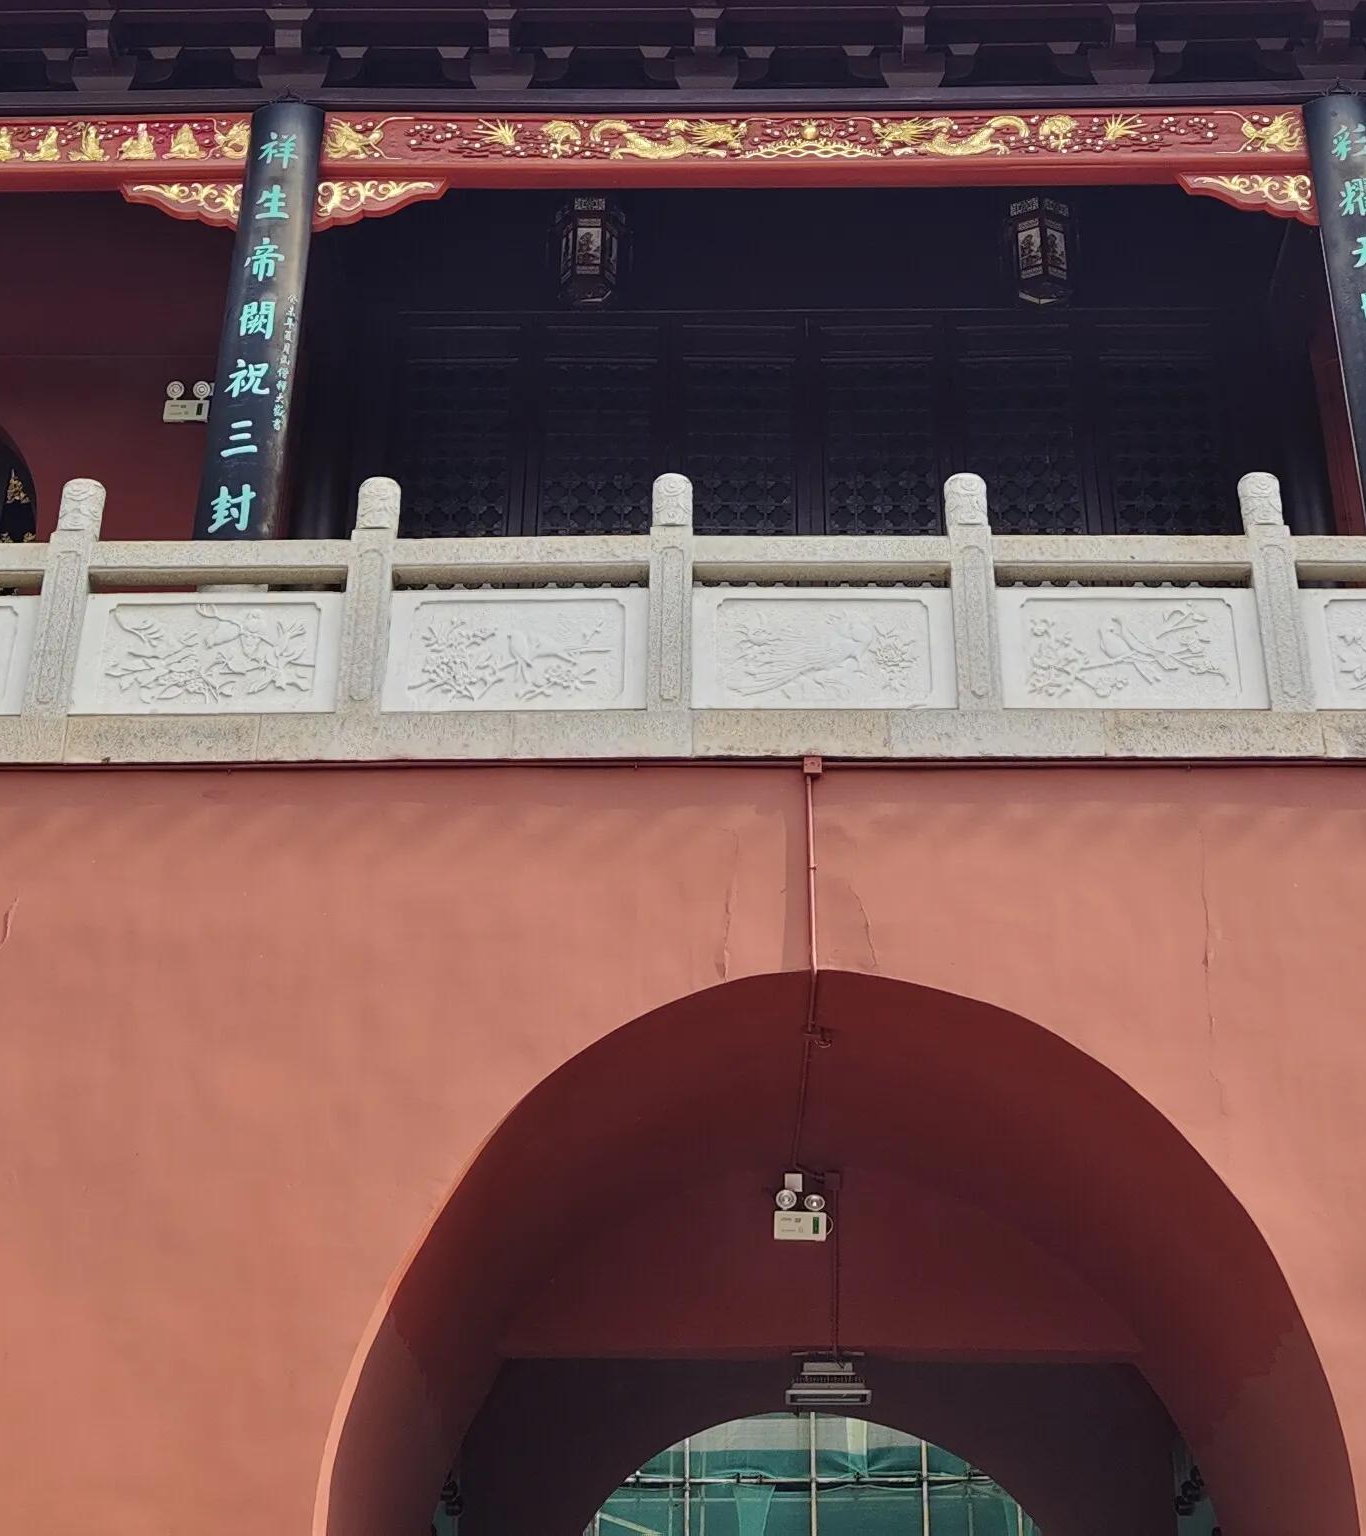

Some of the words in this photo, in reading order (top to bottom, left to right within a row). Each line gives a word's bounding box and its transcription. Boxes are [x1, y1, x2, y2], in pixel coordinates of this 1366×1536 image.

[208, 131, 299, 534] 祥生帝闕祝三封
